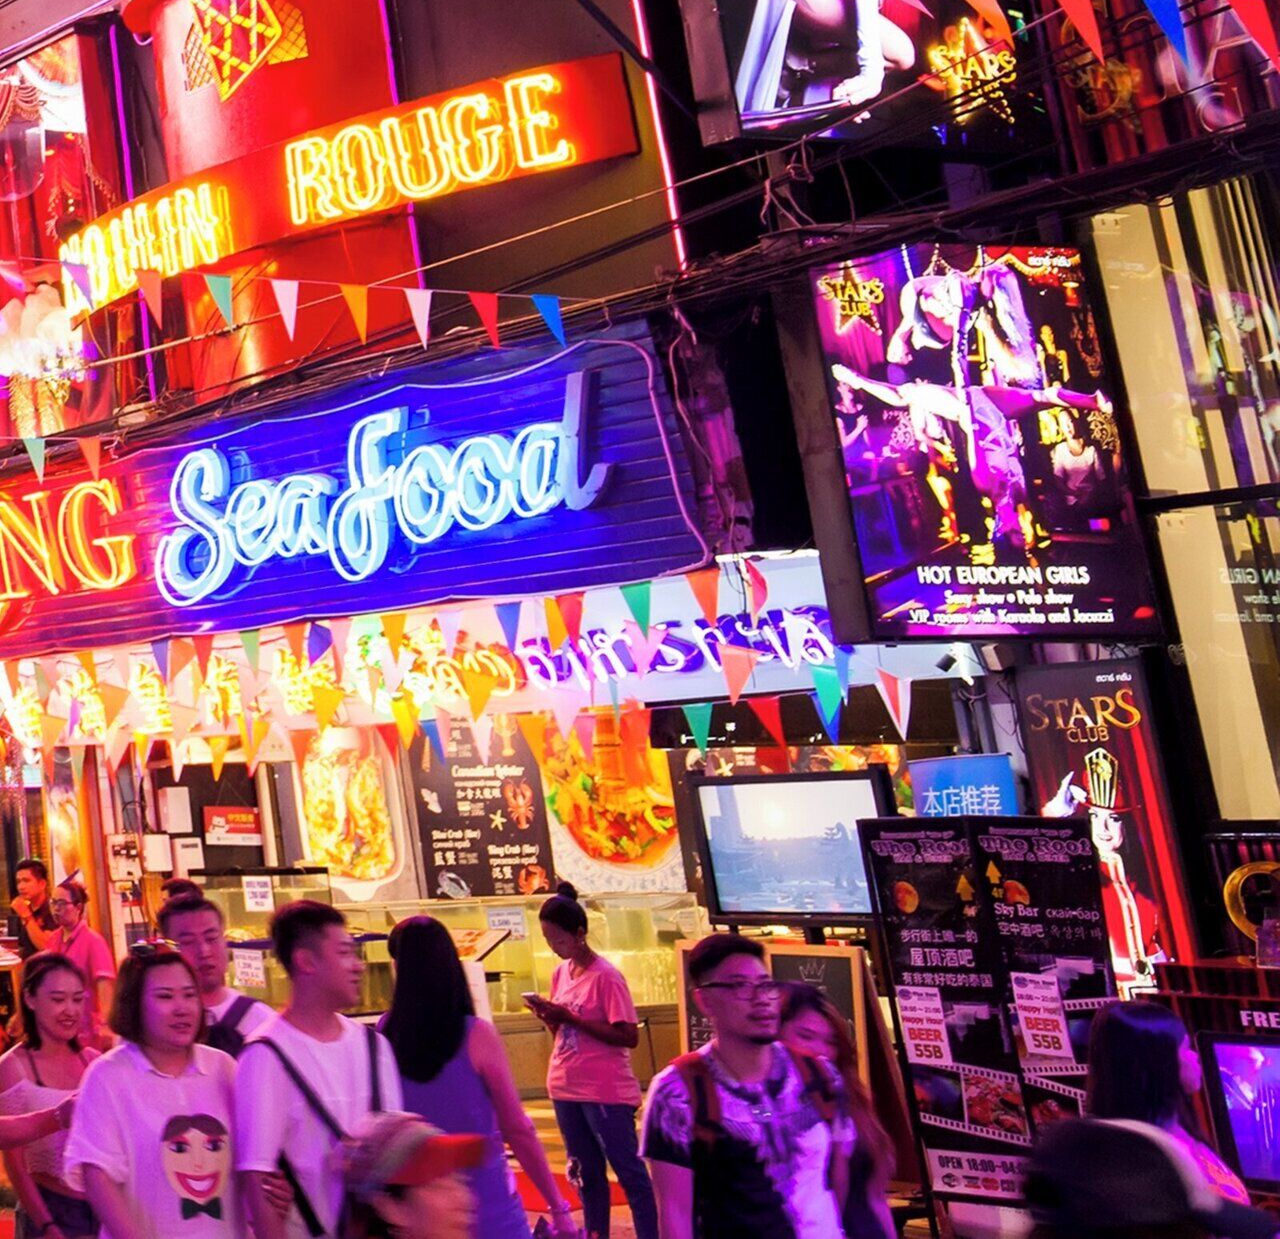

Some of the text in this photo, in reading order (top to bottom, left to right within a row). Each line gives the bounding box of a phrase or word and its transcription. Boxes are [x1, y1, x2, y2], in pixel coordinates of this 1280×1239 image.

[285, 72, 577, 225] ROUGE
[820, 276, 884, 304] STARS
[841, 302, 871, 316] CLUB
[916, 565, 1090, 585] HOT EUROPEAN GIRLS
[1048, 609, 1071, 624] and
[1026, 688, 1141, 731] STARS
[1067, 727, 1109, 743] CLUB
[923, 785, 1003, 816] 本店推荐
[871, 837, 971, 856] The Roof
[978, 835, 1029, 855] The
[1031, 836, 1093, 856] Roof
[994, 902, 1040, 919] Sky Bar
[997, 922, 1045, 938] 空中酒吧
[910, 947, 976, 967] 屋顶酒吧
[1018, 1004, 1042, 1014] Happy
[902, 1015, 943, 1025] Happy Hour
[1025, 1016, 1063, 1033] BEER
[908, 1027, 944, 1043] BEER
[1032, 1033, 1063, 1050] 55B
[914, 1044, 944, 1059] 55B
[938, 1155, 964, 1170] OPEN
